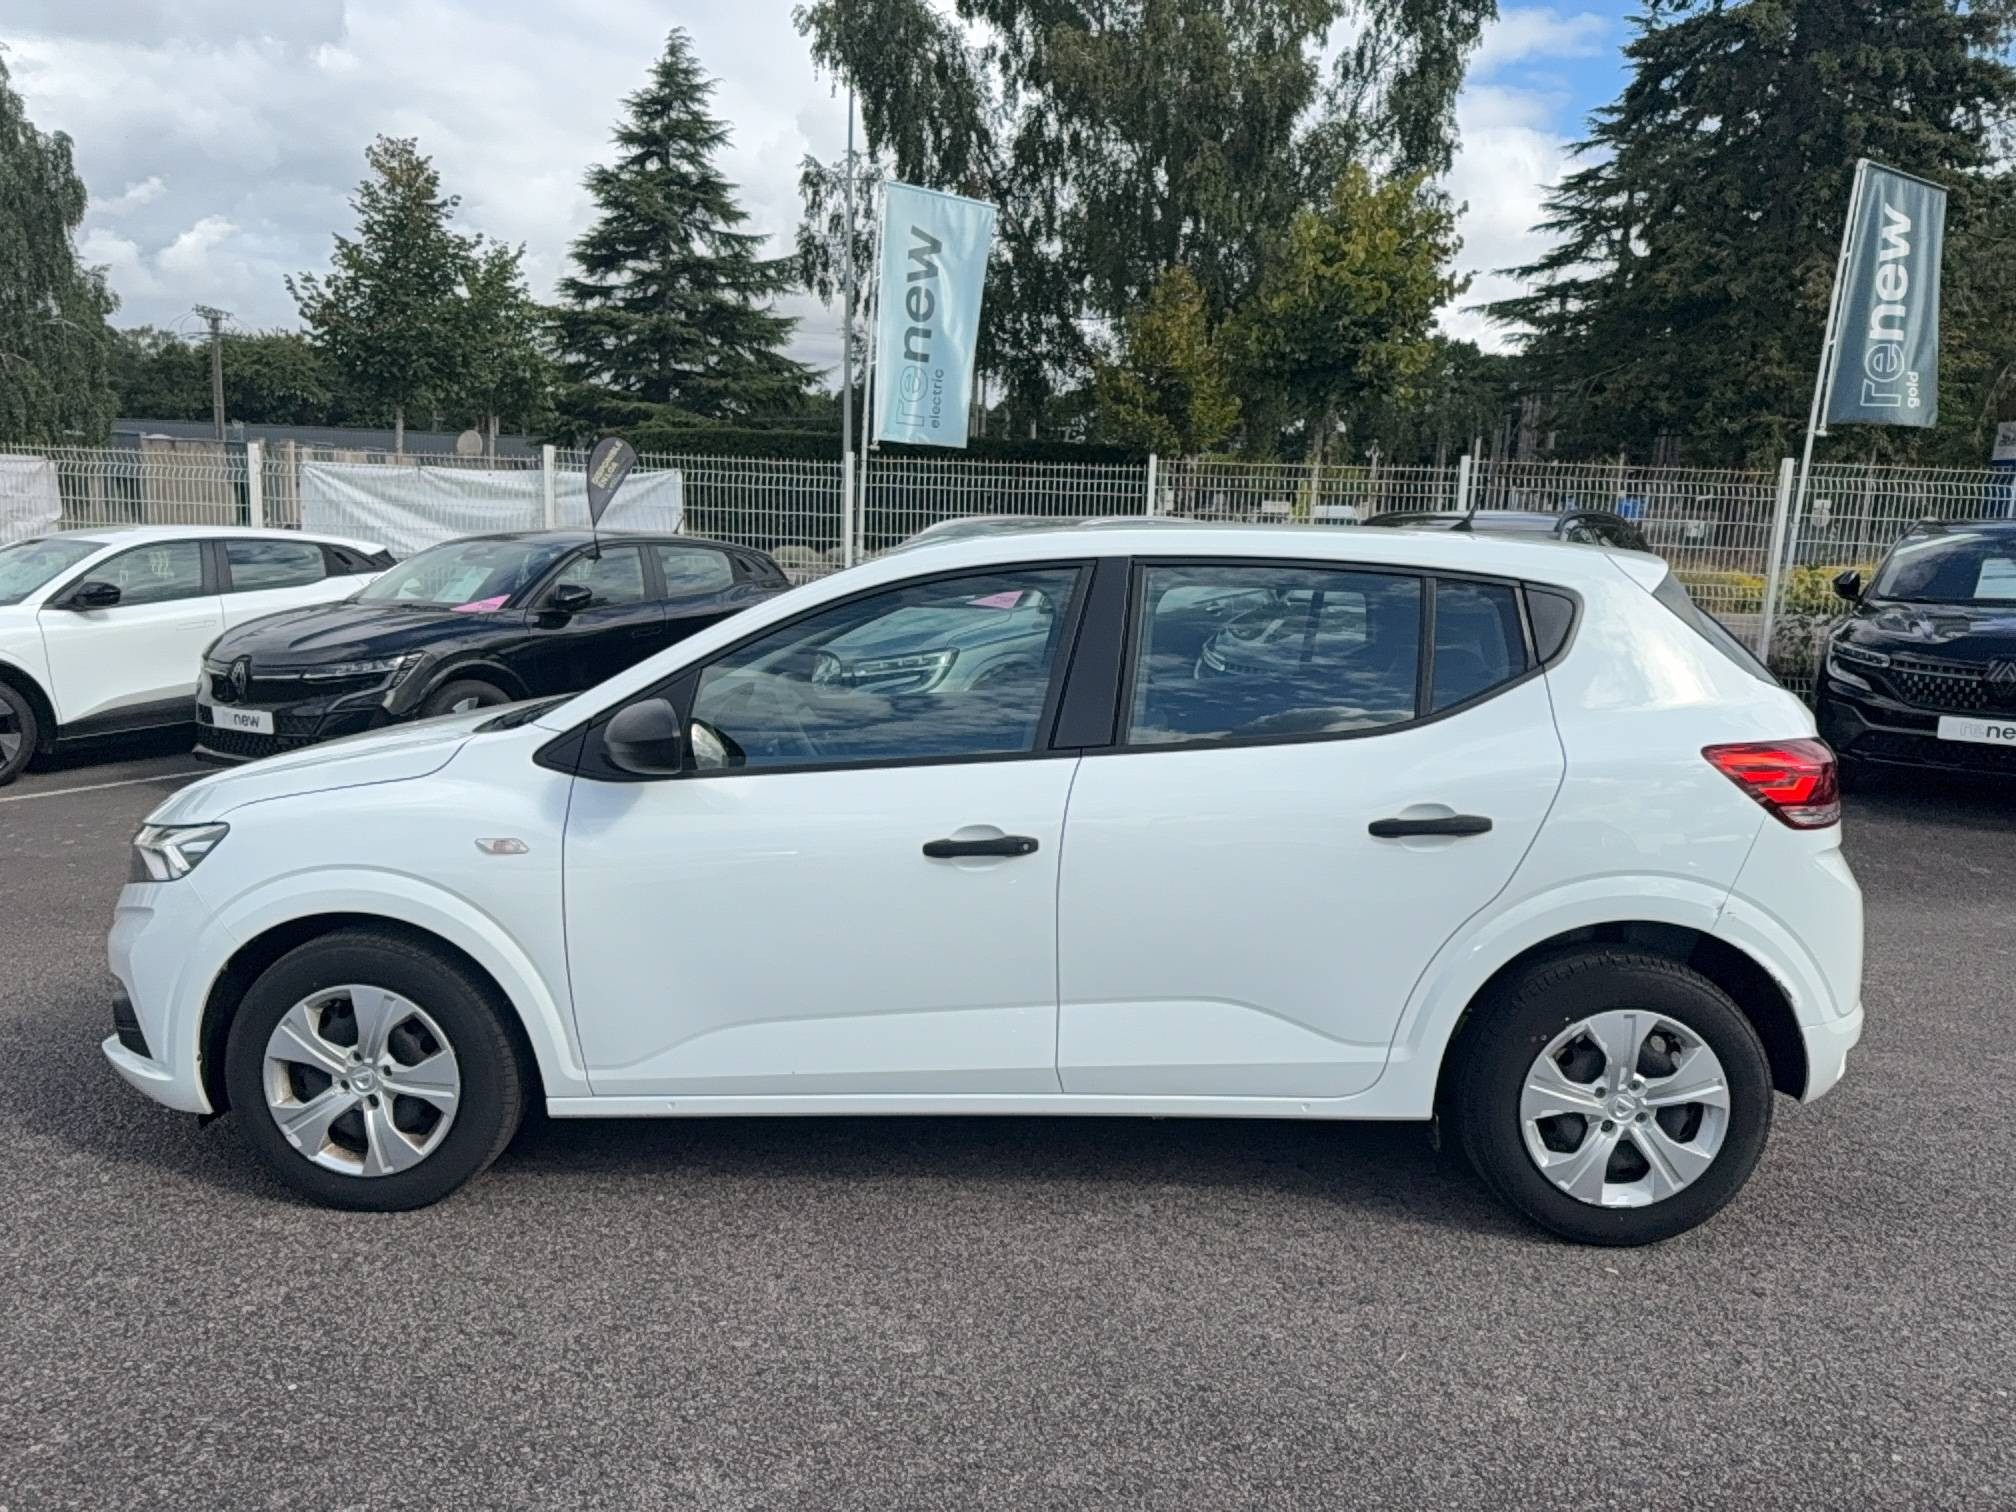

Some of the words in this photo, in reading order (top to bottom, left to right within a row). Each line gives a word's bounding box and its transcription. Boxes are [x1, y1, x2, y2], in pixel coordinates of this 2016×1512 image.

[896, 224, 943, 428] renew
[1860, 202, 1912, 408] renew
[929, 368, 944, 429] electric
[1905, 371, 1920, 409] gold
